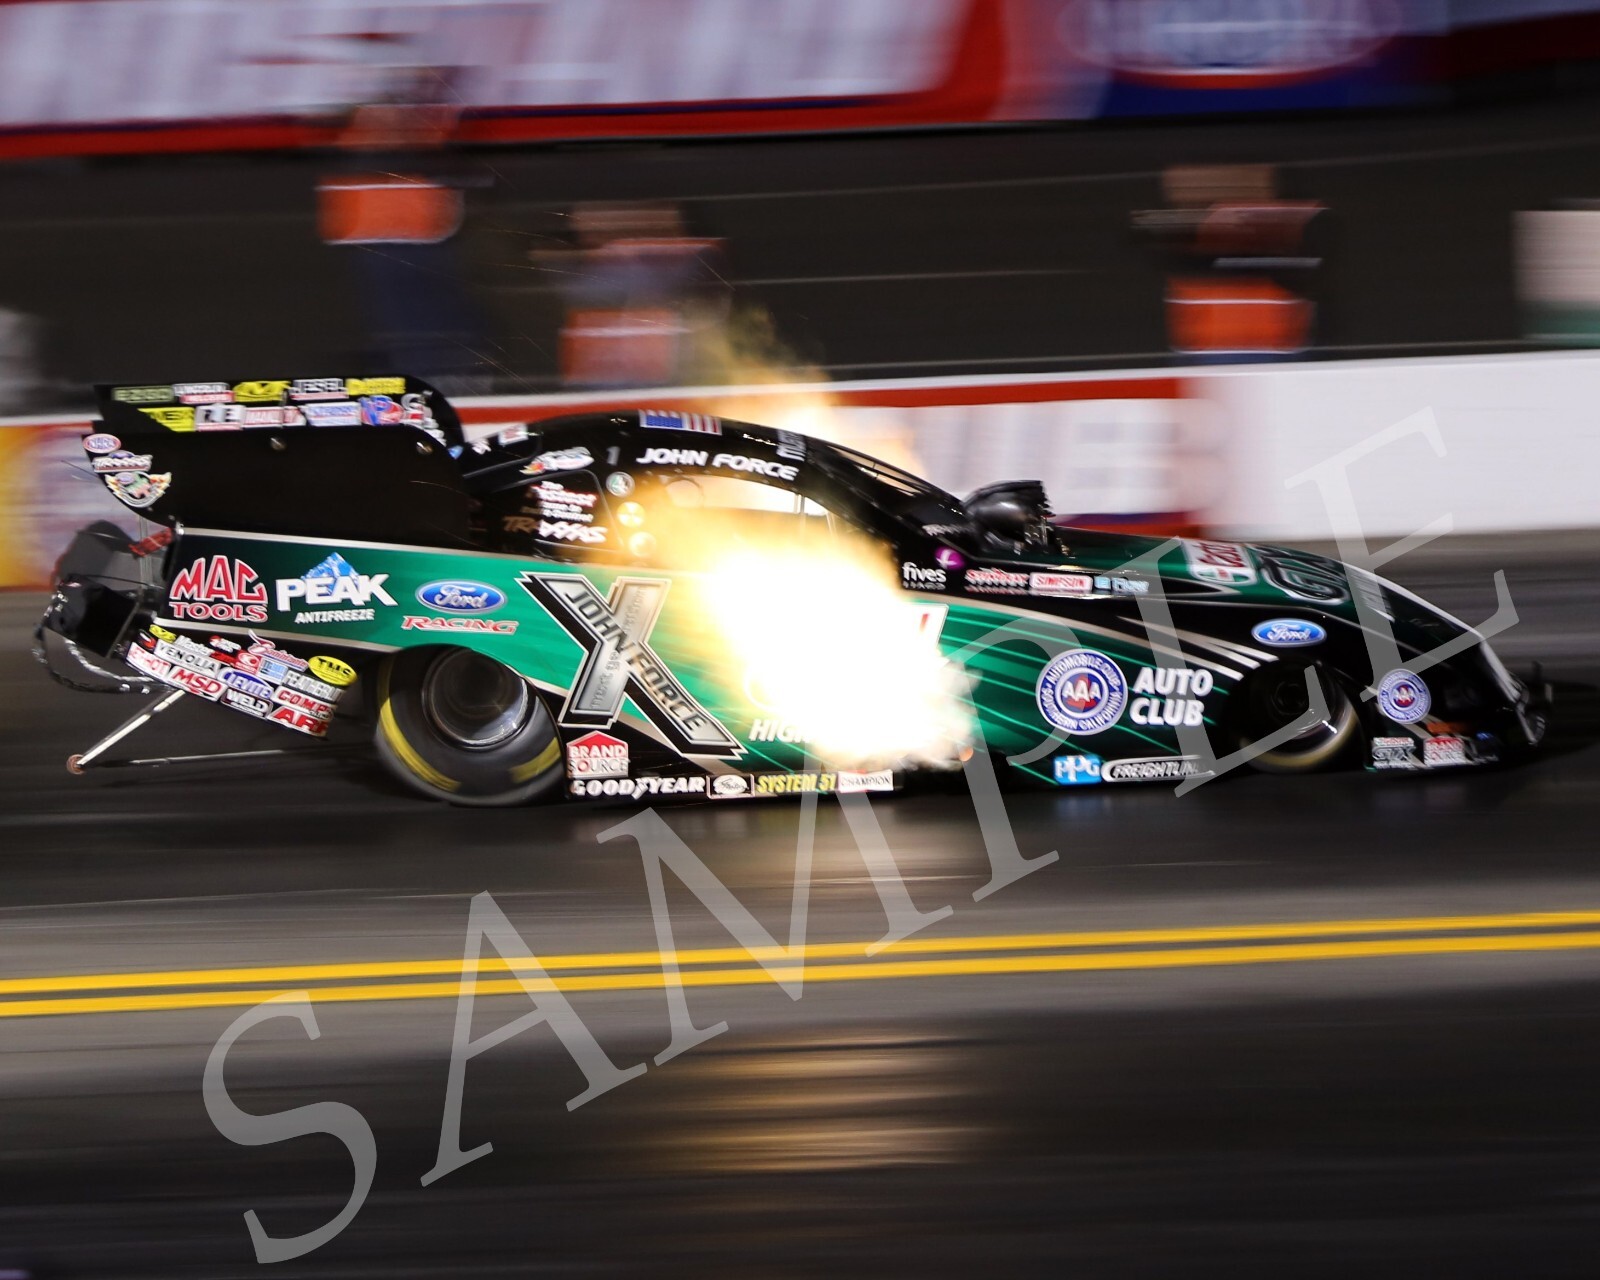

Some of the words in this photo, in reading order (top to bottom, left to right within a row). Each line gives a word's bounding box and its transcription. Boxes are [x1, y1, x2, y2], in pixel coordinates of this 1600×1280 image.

[636, 448, 709, 467] JOHN
[712, 453, 800, 481] FORCE
[170, 554, 269, 604] MAC
[902, 562, 946, 583] fives
[275, 573, 398, 612] PEAK
[433, 584, 489, 609] Ford
[168, 601, 269, 623] TOOLS
[295, 608, 375, 624] ANTIFREEZE
[401, 616, 519, 636] RACING
[1266, 622, 1311, 641] Ford
[160, 643, 218, 672] VENOLIA
[564, 591, 638, 654] JOHN
[625, 649, 709, 732] FORCE
[172, 668, 222, 694] MSD
[1061, 679, 1103, 703] AAA
[1132, 667, 1214, 697] AUTO
[226, 689, 269, 713] WELD
[1129, 697, 1205, 726] CLUB
[568, 743, 626, 759] BRAND
[569, 758, 630, 774] SOURCE
[1055, 755, 1101, 782] PPG
[571, 776, 706, 800] GOODYEAR
[756, 773, 817, 794] SYSTEM
[840, 775, 892, 789] CHAMPION
